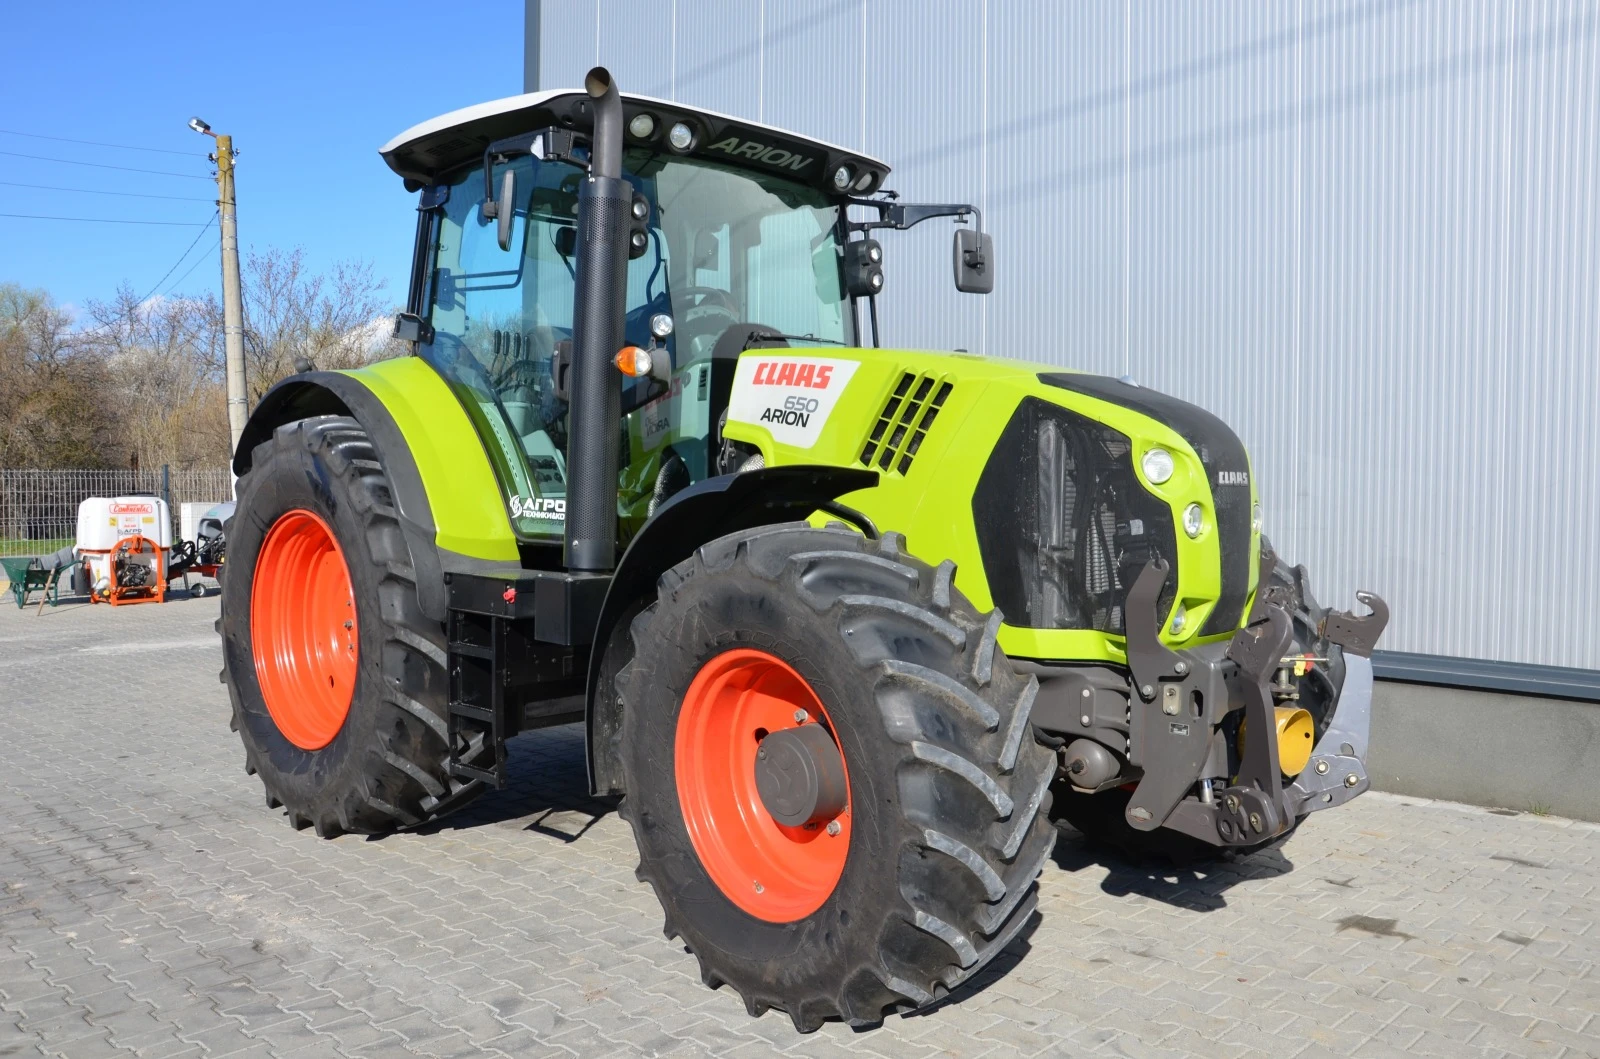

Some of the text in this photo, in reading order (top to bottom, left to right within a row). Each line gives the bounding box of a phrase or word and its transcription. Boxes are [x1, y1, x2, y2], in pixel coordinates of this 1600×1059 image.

[707, 137, 814, 170] ARION
[752, 362, 834, 390] CLAAS
[784, 395, 819, 413] 650
[760, 407, 810, 428] ARION
[1218, 471, 1248, 485] CLAAS
[523, 498, 566, 512] АГРО
